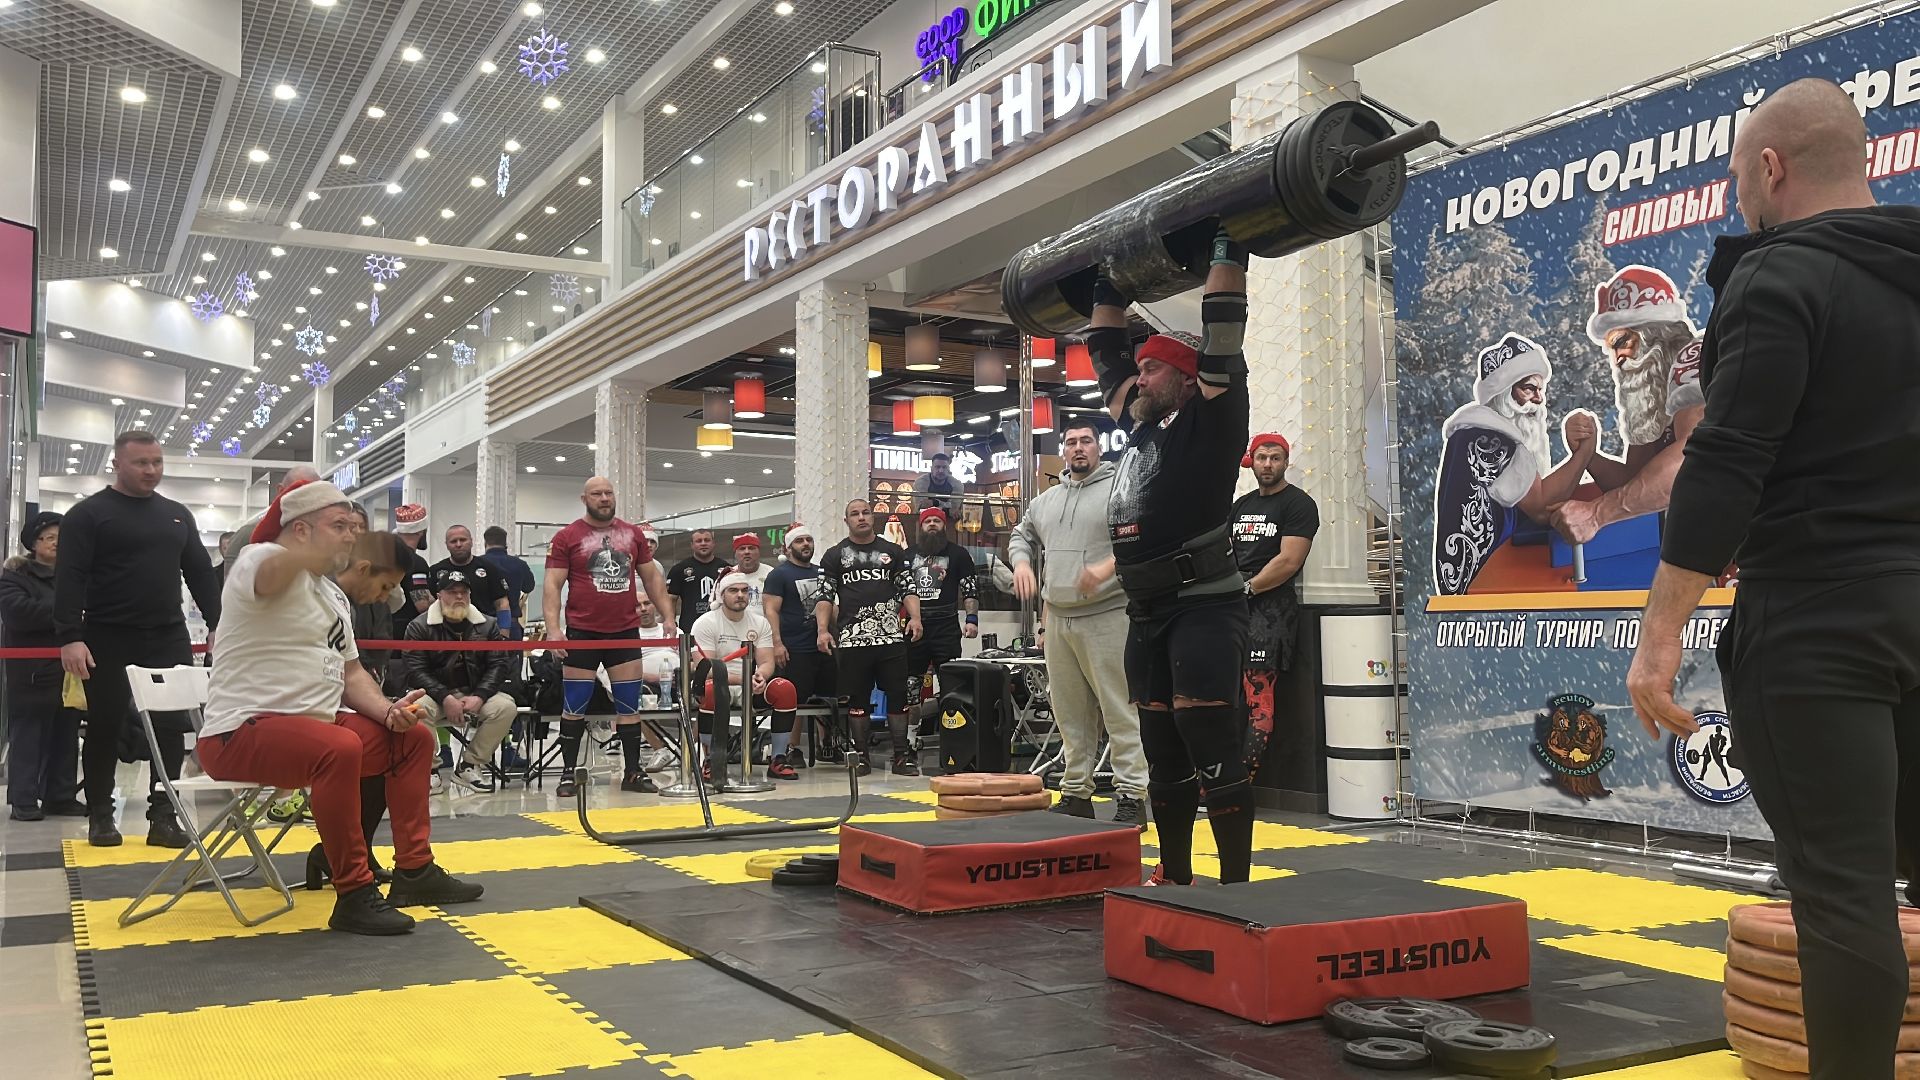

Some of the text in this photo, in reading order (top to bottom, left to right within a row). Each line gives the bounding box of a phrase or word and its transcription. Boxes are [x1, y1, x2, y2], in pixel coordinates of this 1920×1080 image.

[916, 7, 966, 59] GOOD
[921, 38, 959, 82] GYM
[744, 0, 1173, 282] РЕСТОРАННЫЙ
[1604, 180, 1728, 246] СИЛОВЫХ
[842, 568, 892, 585] RUSSIA
[1436, 613, 1527, 648] ОТКРЫТЫЙ
[1535, 619, 1604, 649] ТУРНИР
[1613, 619, 1641, 649] ПО
[1536, 744, 1614, 776] armwrestling
[1678, 739, 1686, 763] СИЛОВ
[1697, 716, 1711, 725] ДОВ
[1715, 716, 1729, 725] СПО
[966, 853, 1110, 884] YOUSTEEL
[1317, 936, 1491, 981] YOUSTEEL
